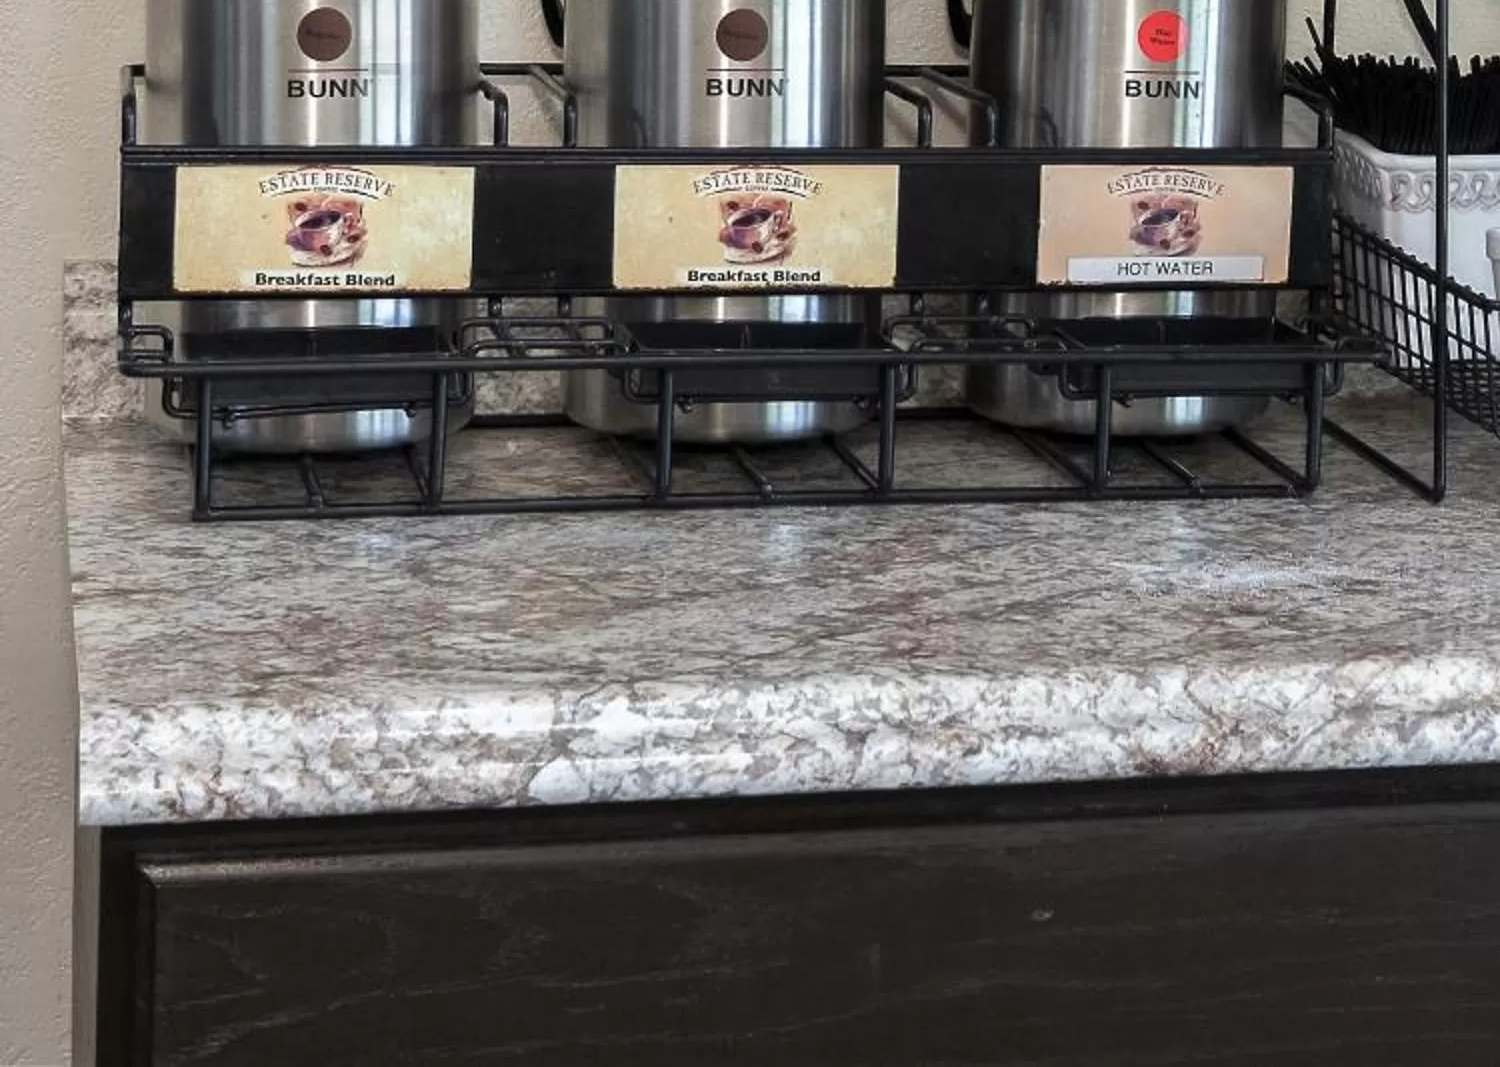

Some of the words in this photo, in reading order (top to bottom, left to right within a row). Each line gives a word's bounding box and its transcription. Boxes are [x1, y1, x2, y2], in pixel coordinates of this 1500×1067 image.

[287, 78, 369, 98] BUNN
[706, 78, 785, 97] BUNN
[1125, 80, 1200, 99] BUNN
[259, 172, 320, 195] ESTATE
[325, 172, 396, 197] RESERVE
[693, 172, 751, 194] ESTATE
[755, 172, 823, 195] RESERVE
[1107, 174, 1161, 195] ESTATE
[1164, 174, 1227, 196] RESERVE
[687, 270, 769, 283] Breakfast
[773, 270, 821, 282] Blend
[1117, 262, 1152, 276] HOT
[1156, 261, 1214, 276] WATER
[255, 272, 340, 286] Breakfast
[345, 273, 396, 286] Blend
